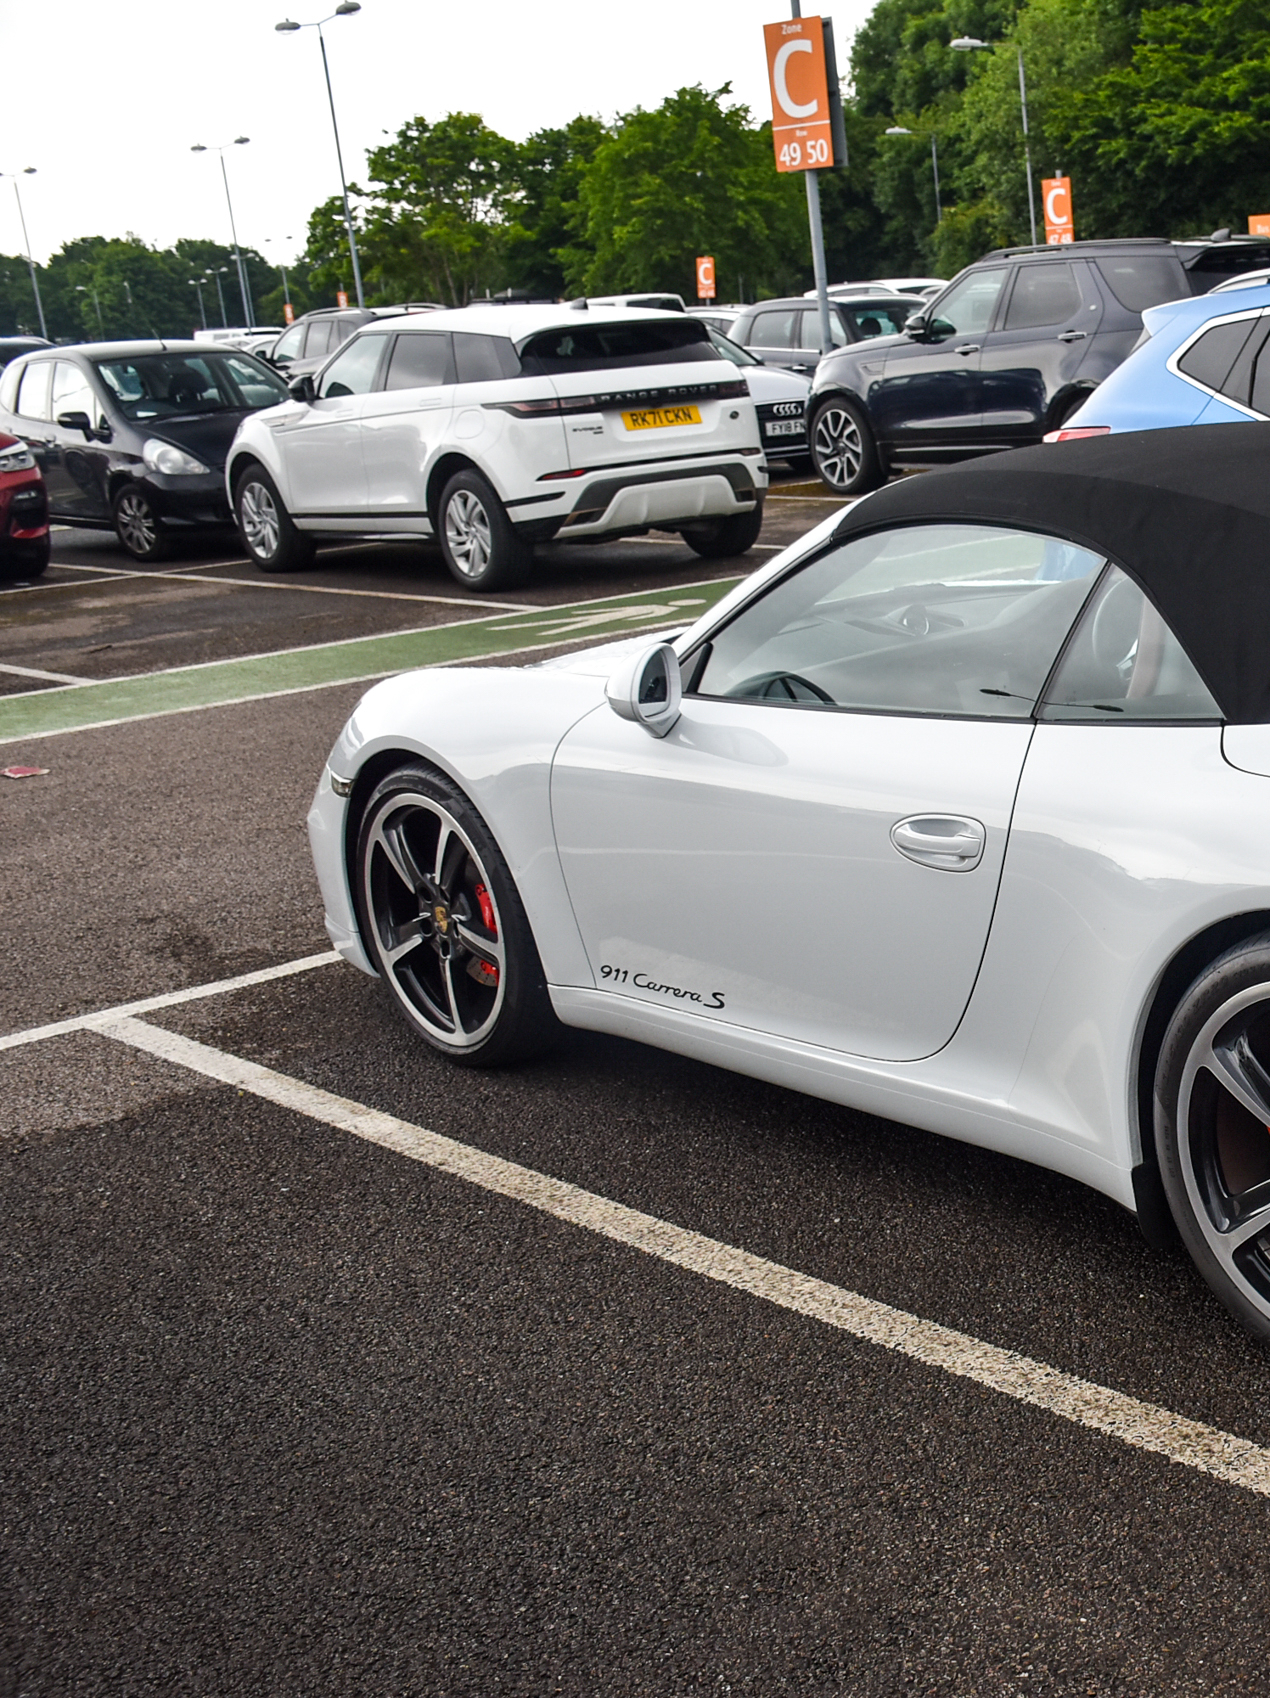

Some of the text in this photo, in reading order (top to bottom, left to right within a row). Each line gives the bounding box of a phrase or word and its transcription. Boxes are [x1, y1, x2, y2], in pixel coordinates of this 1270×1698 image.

[781, 24, 802, 35] Zone
[773, 38, 818, 119] C
[779, 139, 828, 167] 49 50
[1046, 187, 1068, 225] C
[1256, 224, 1270, 234] Bus
[698, 263, 712, 285] C
[601, 385, 717, 401] RANGE ROVER
[629, 407, 694, 428] RK71 CKN
[600, 964, 726, 1010] 911 Carrera S
